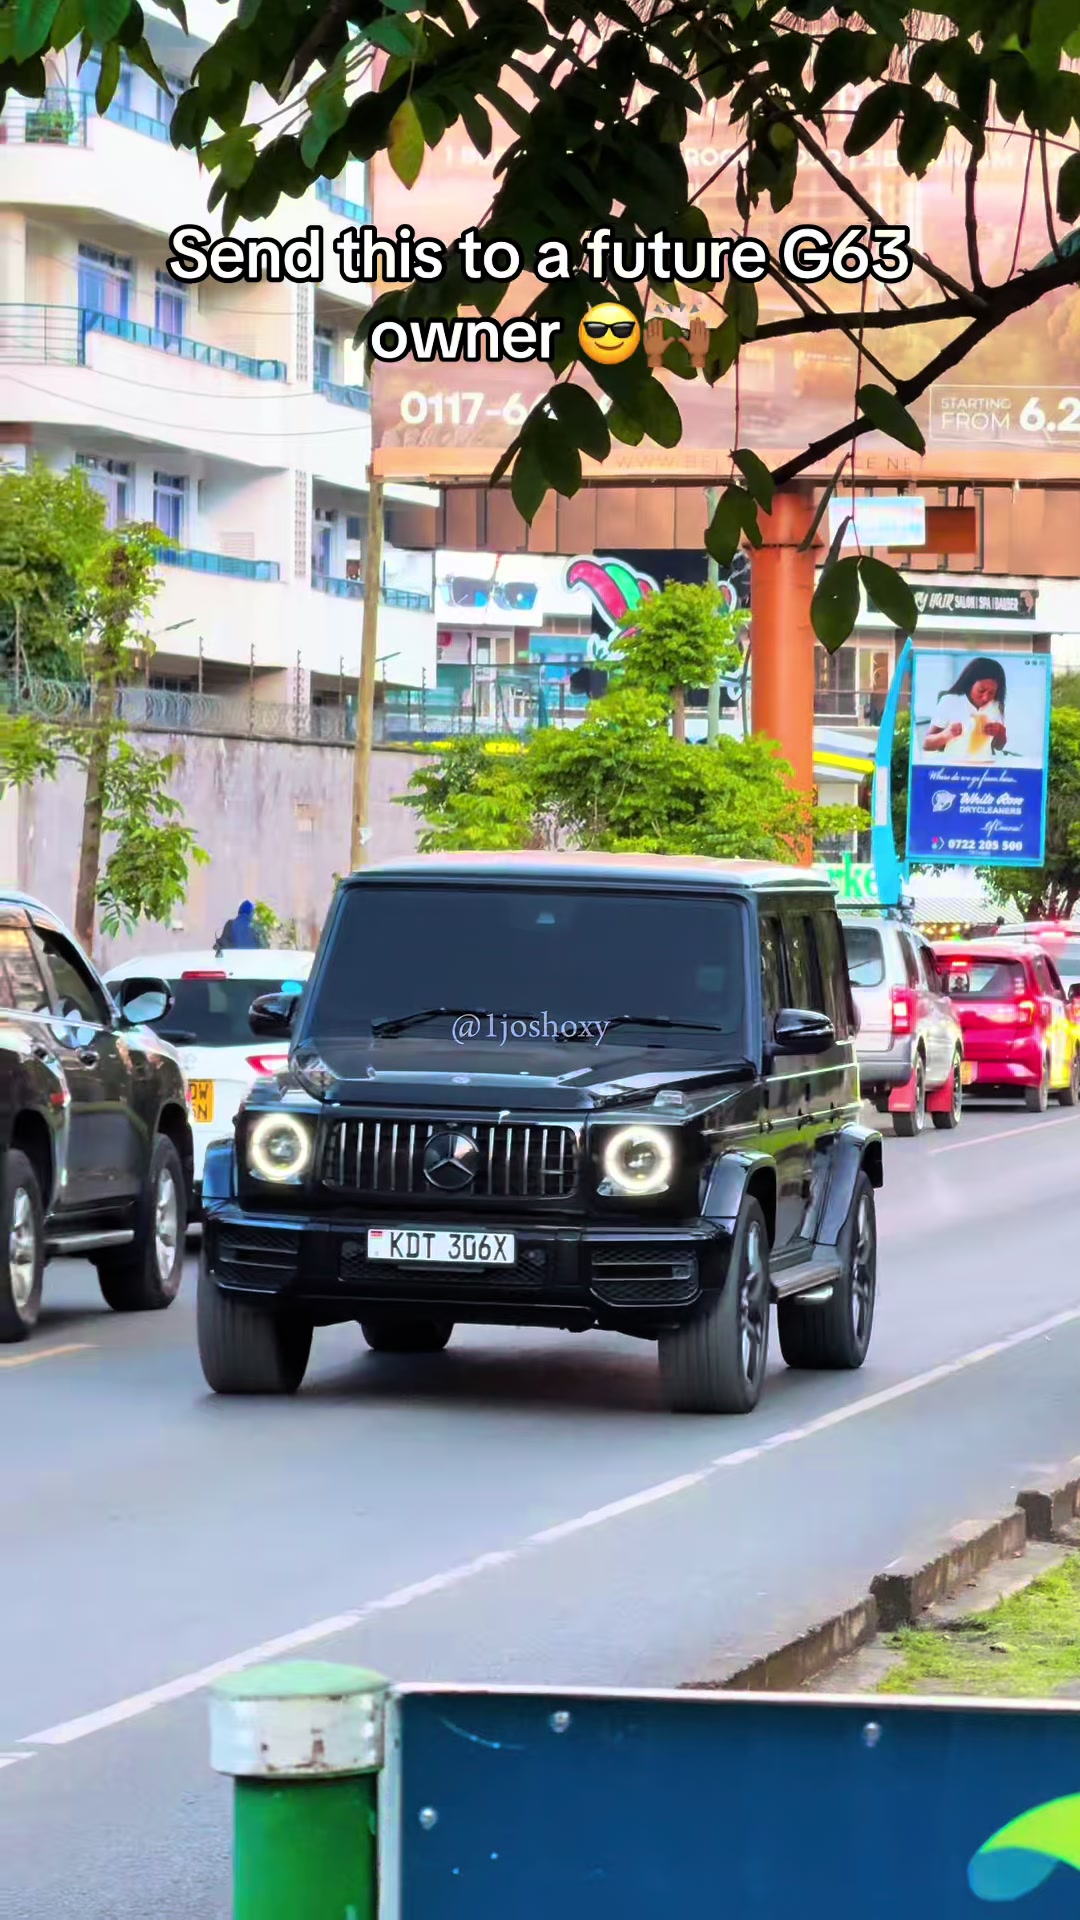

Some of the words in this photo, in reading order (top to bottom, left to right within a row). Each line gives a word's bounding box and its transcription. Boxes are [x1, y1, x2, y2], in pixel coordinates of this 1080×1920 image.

[941, 397, 1012, 410] STARTING
[941, 412, 1010, 431] FROM
[959, 805, 1022, 815] DRYCLEANERS
[948, 839, 976, 849] 0722
[978, 840, 999, 850] 205
[390, 1231, 436, 1259] KDT
[448, 1233, 507, 1261] 306X
